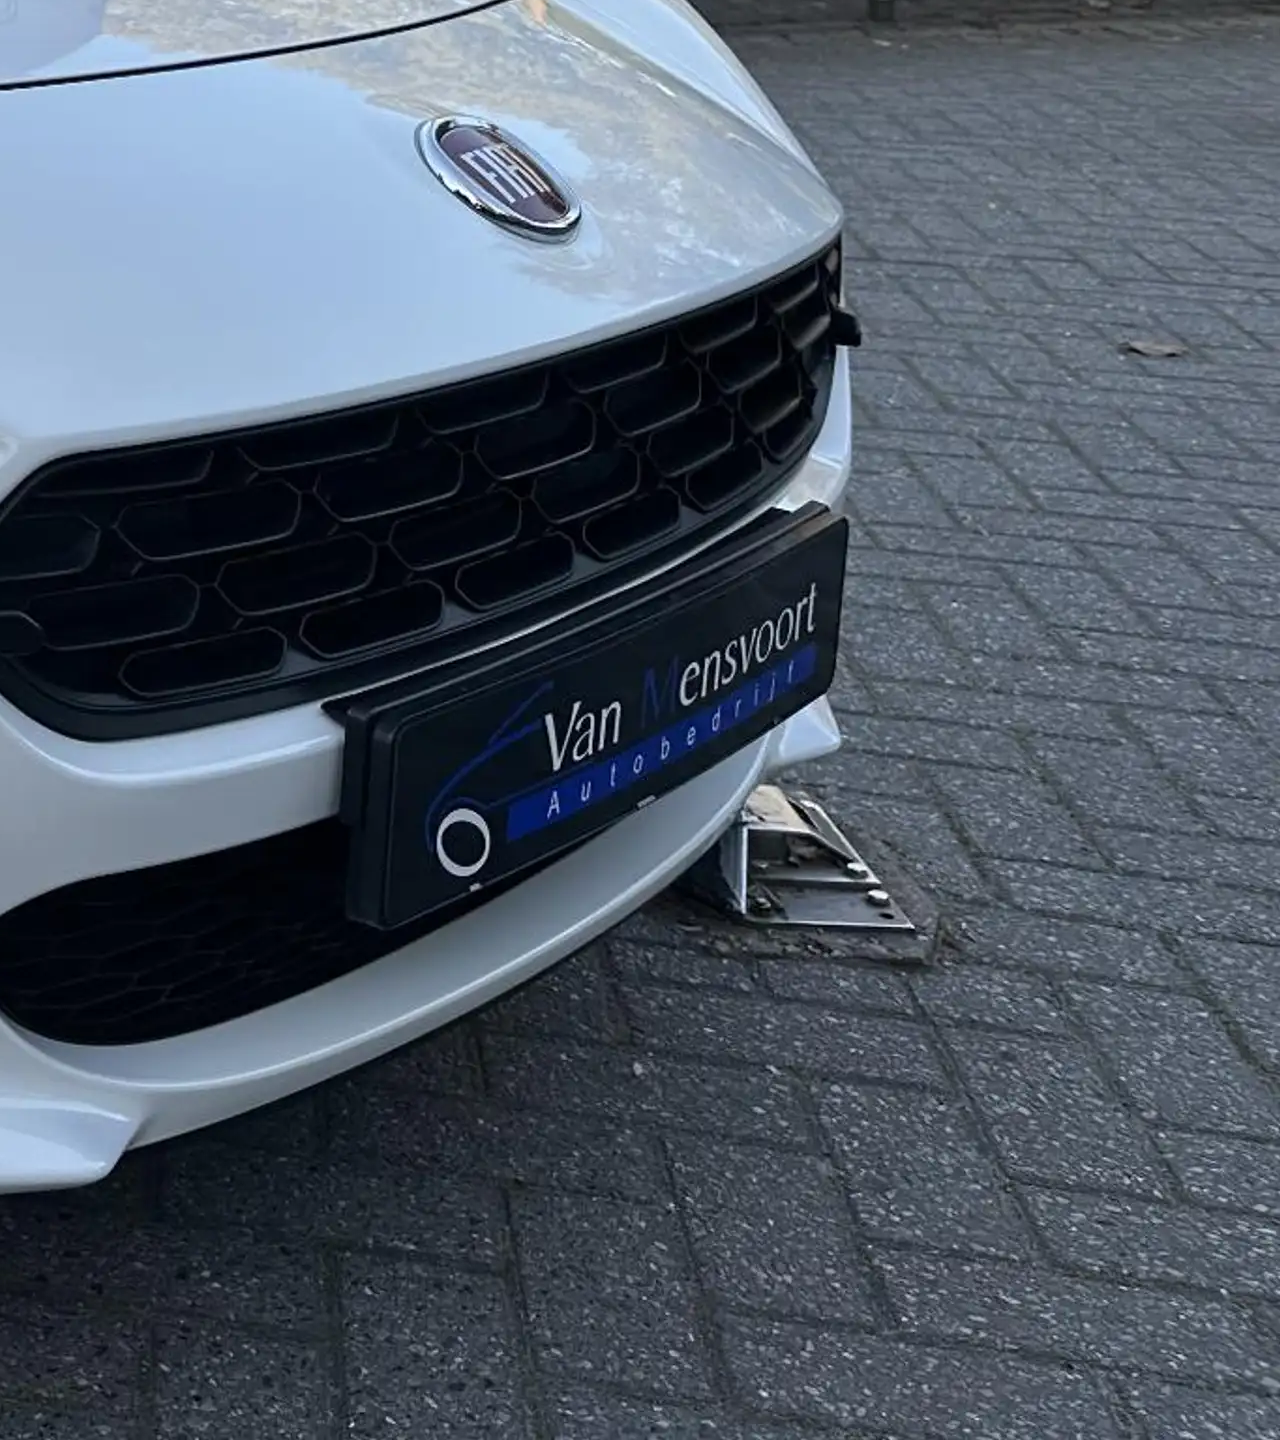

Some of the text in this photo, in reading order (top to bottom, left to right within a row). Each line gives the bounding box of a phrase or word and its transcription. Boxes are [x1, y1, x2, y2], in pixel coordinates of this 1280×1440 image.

[460, 143, 551, 204] FIAT
[543, 582, 818, 772] Van Mensvoort
[547, 660, 798, 820] Autobedrijf
